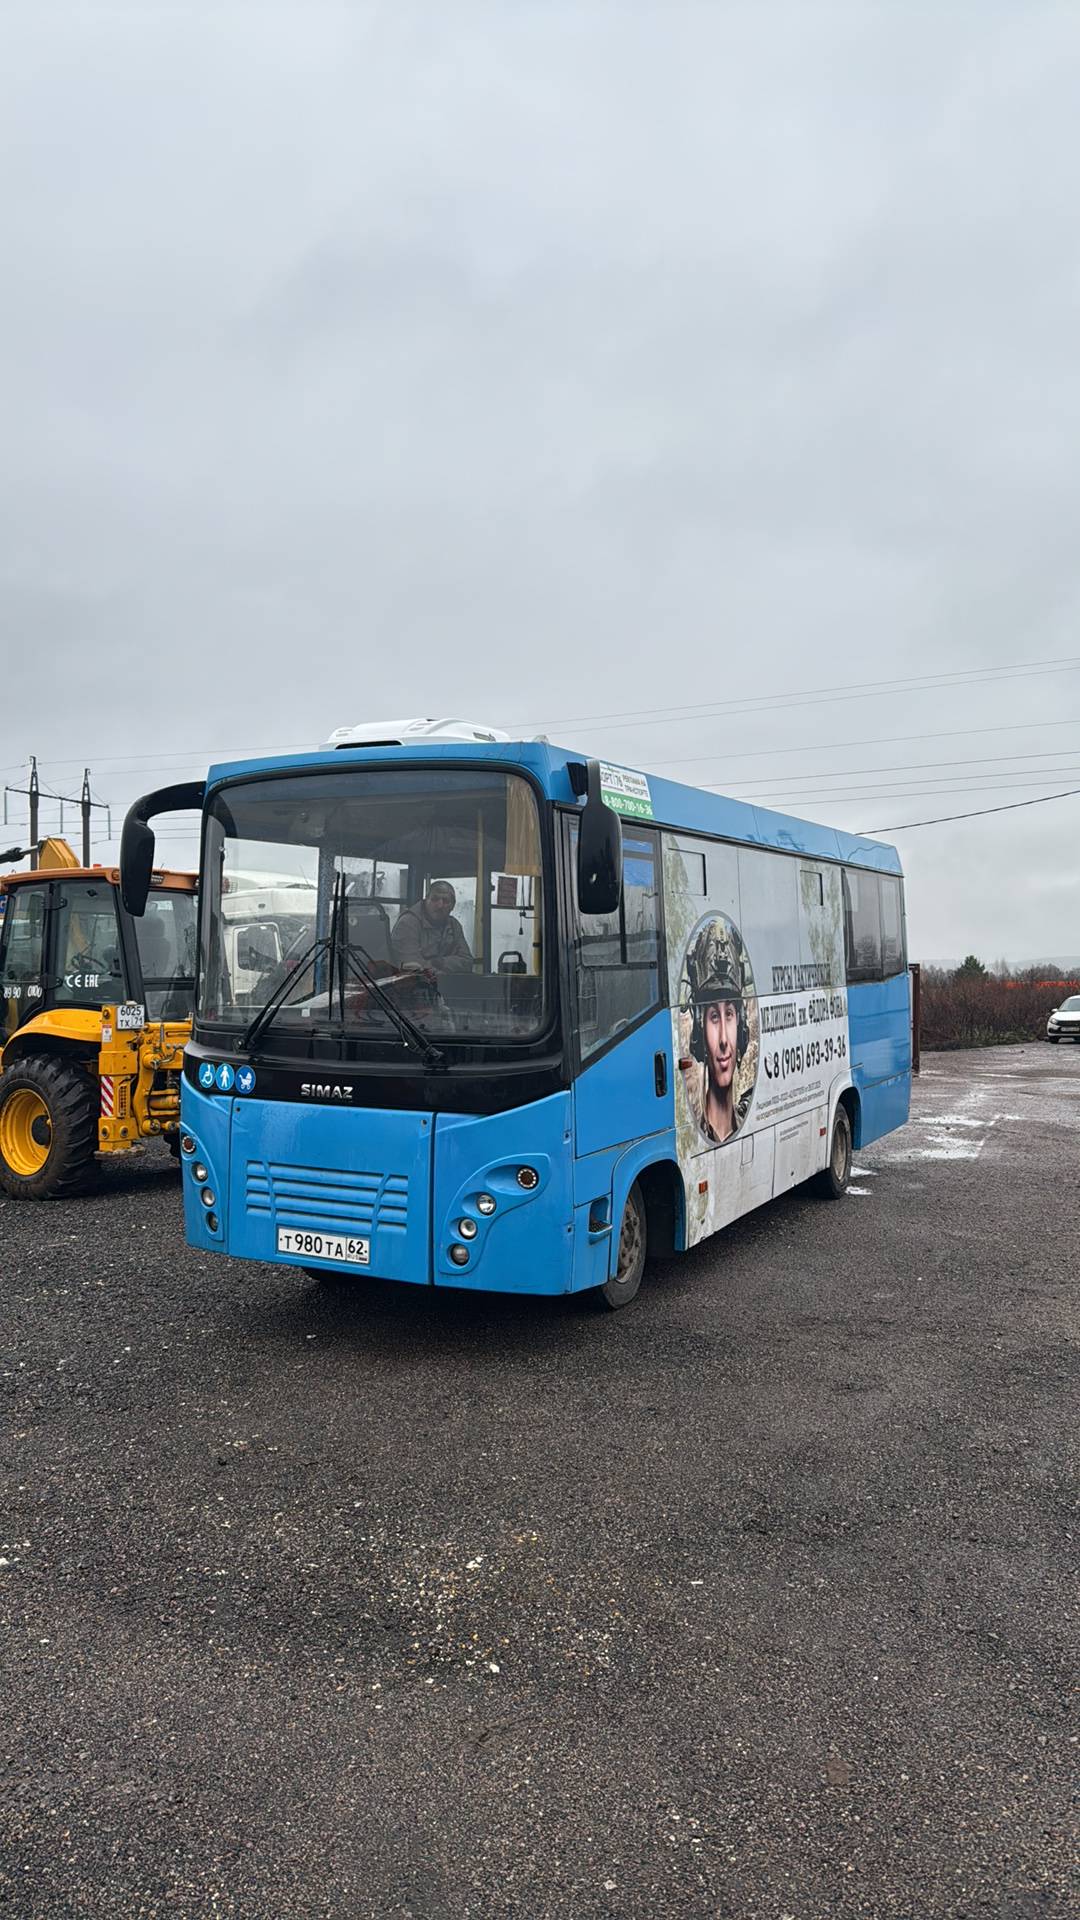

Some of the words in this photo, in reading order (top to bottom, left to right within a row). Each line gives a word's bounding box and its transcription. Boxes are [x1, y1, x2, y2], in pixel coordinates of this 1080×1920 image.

[120, 1006, 141, 1017] 6025
[774, 1052, 780, 1078] 8
[782, 1044, 804, 1080] (905)
[806, 1035, 846, 1068] 693-39-36
[301, 1083, 354, 1099] SIMAZ
[348, 1239, 364, 1255] 62
